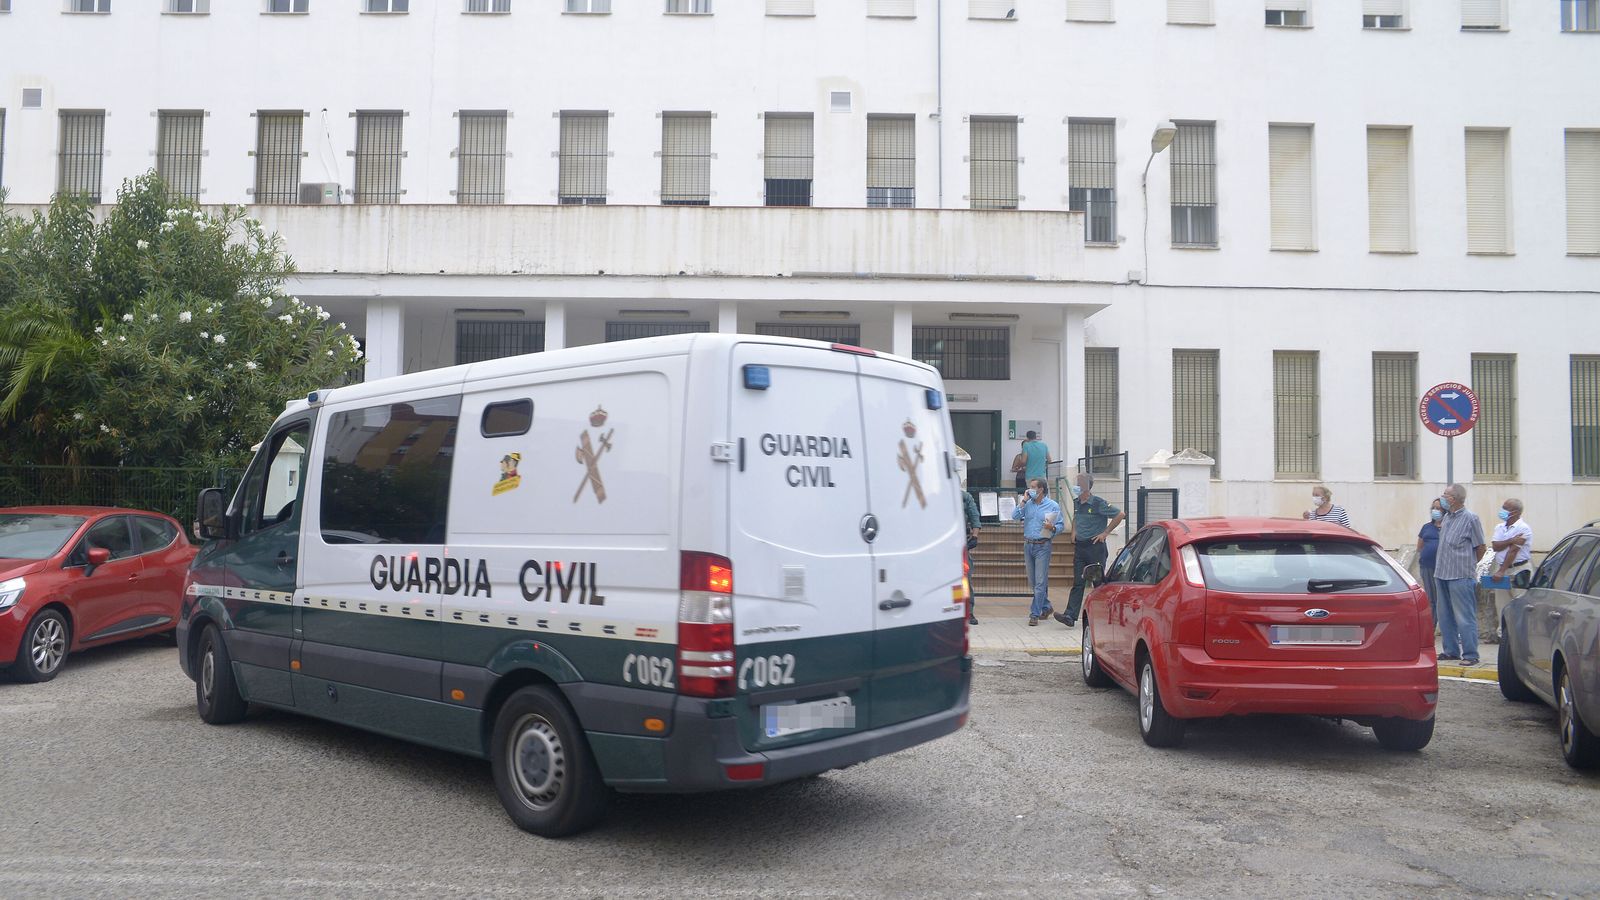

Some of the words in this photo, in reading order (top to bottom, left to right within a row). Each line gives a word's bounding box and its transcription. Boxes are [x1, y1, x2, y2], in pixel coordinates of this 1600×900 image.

[1421, 397, 1430, 425] EXCEPTO
[1427, 384, 1462, 397] SERVICIOS
[1462, 388, 1478, 422] JUDICIALES
[760, 433, 852, 459] GUARDIA
[786, 464, 836, 488] CIVIL
[369, 554, 492, 599] GUARDIA
[518, 559, 605, 606] CIVIL
[636, 654, 675, 689] 062
[753, 653, 796, 688] 062
